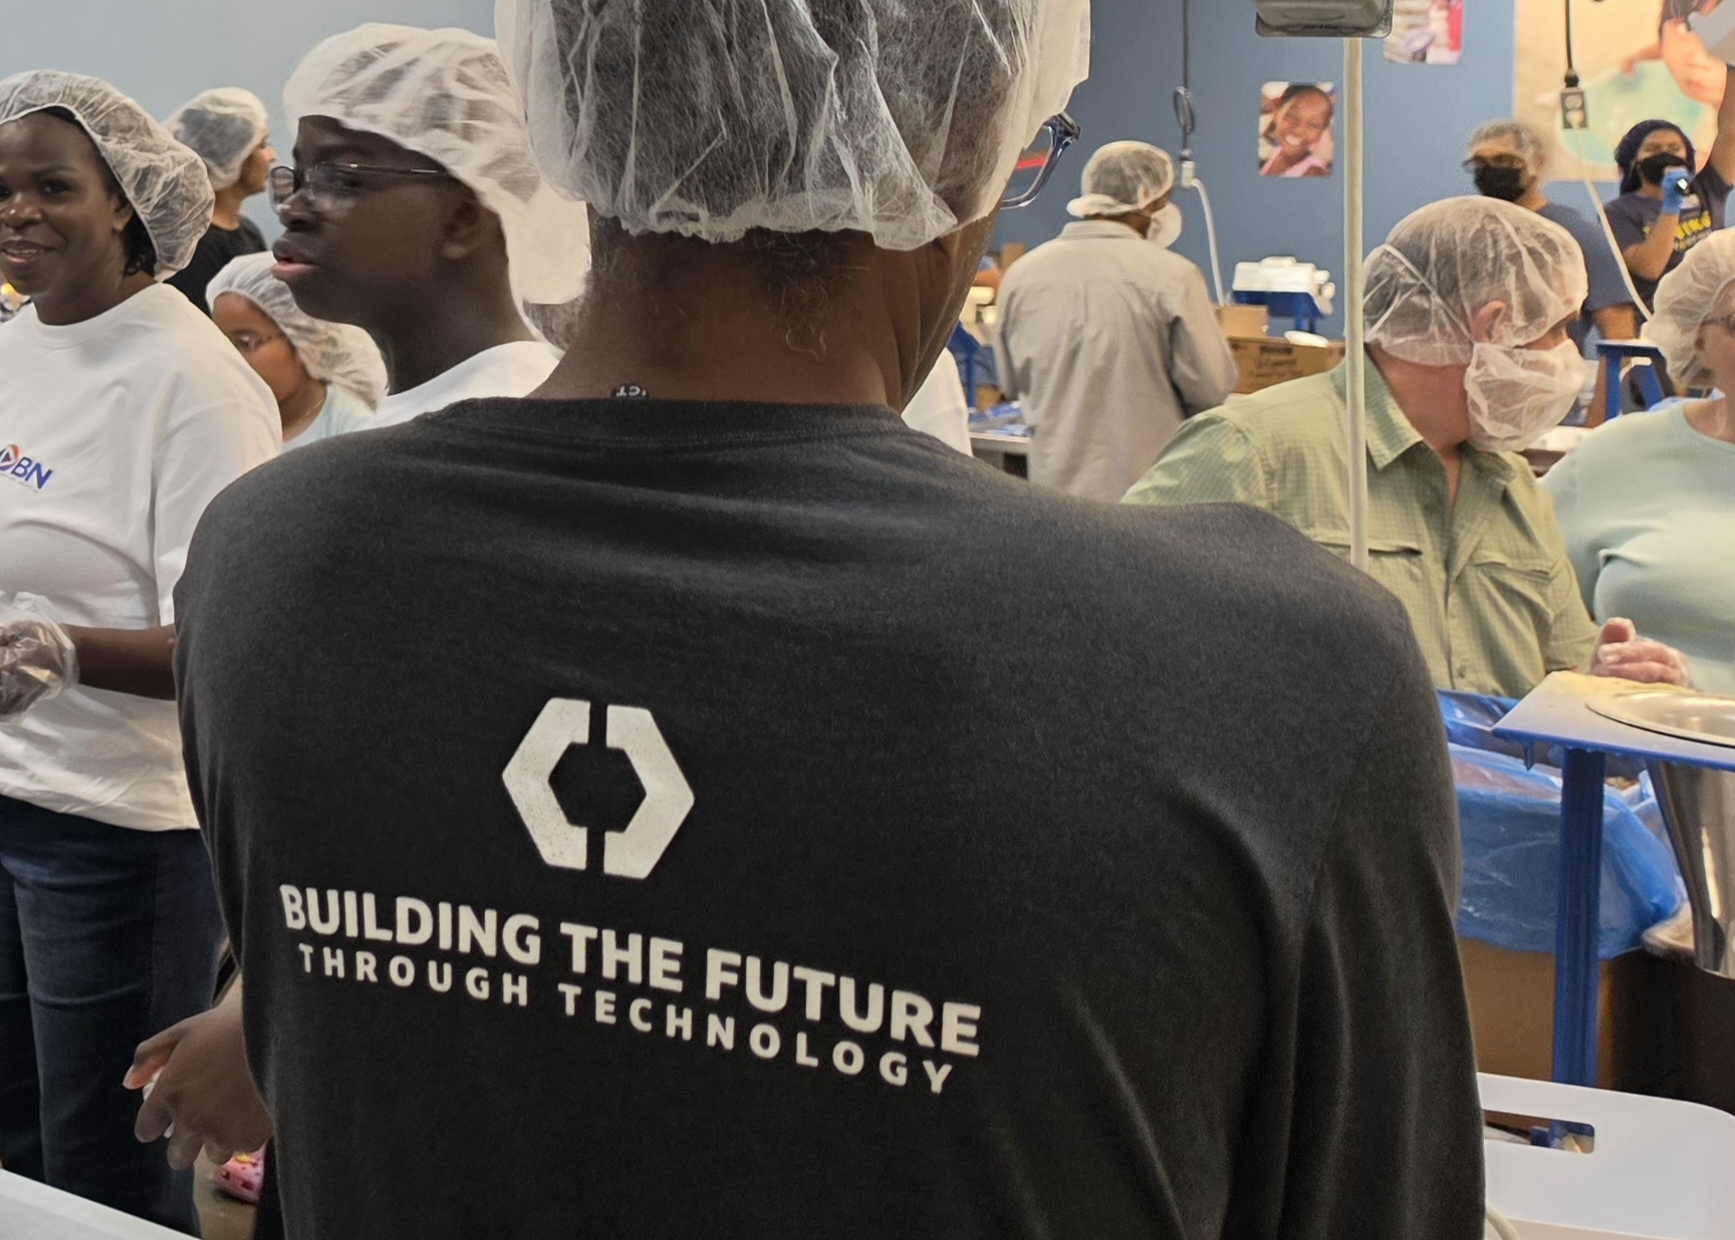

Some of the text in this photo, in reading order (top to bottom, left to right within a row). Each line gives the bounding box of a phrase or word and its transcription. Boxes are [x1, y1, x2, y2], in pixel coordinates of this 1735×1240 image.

[279, 884, 982, 1058] BUILDING THE FUTURE
[298, 942, 953, 1094] THROUGH TECHNOLOGY
